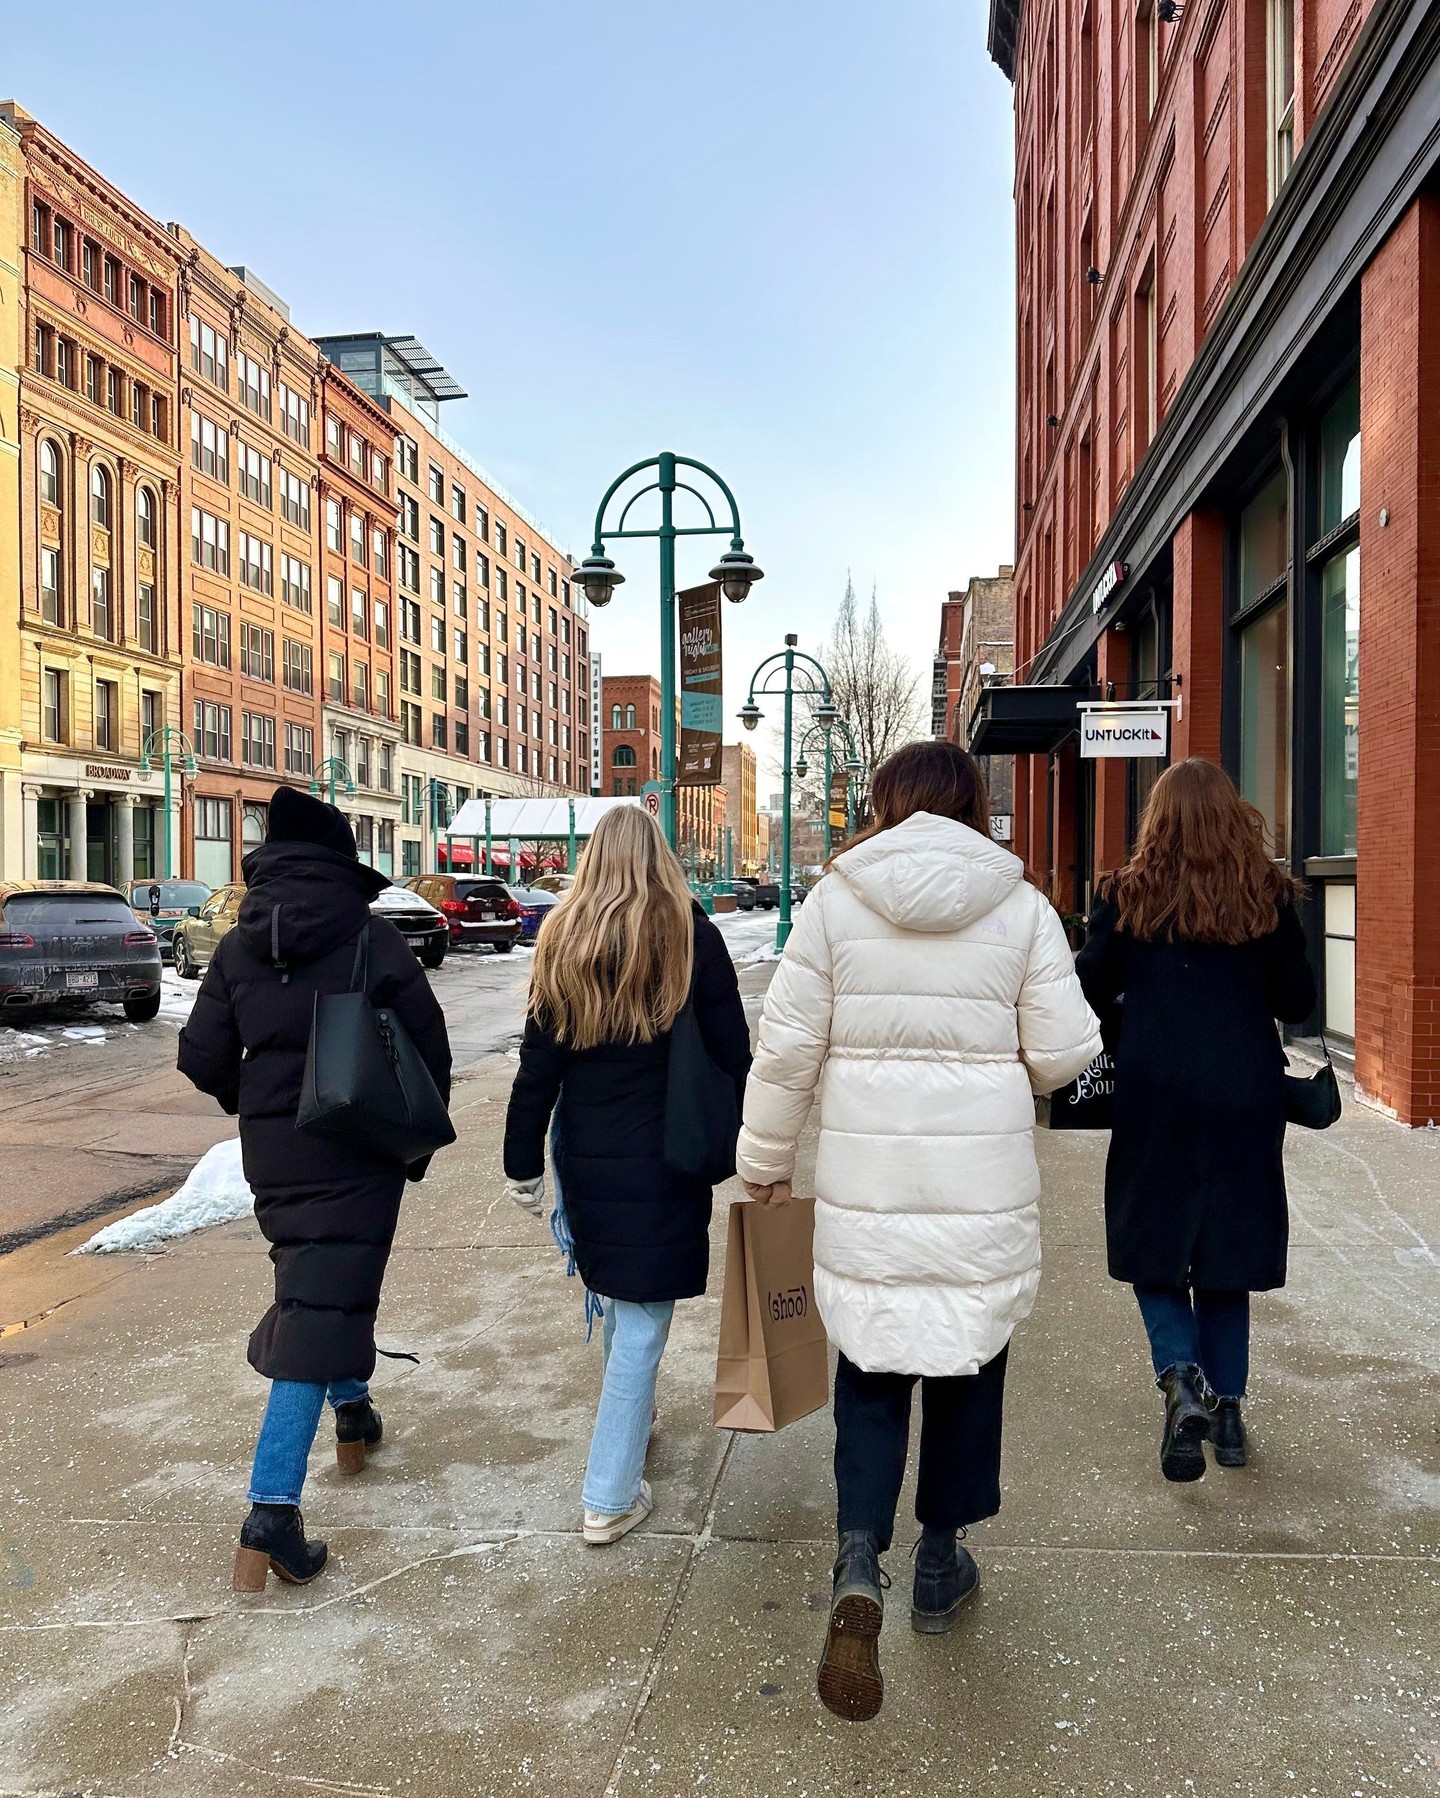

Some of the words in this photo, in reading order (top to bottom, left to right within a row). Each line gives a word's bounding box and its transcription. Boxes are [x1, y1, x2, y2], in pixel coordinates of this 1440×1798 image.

[682, 627, 713, 650] gallery
[684, 641, 706, 663] night
[702, 663, 721, 673] SATURDAY
[1085, 728, 1150, 741] UNTUCKit
[86, 764, 132, 781] BROADWAY
